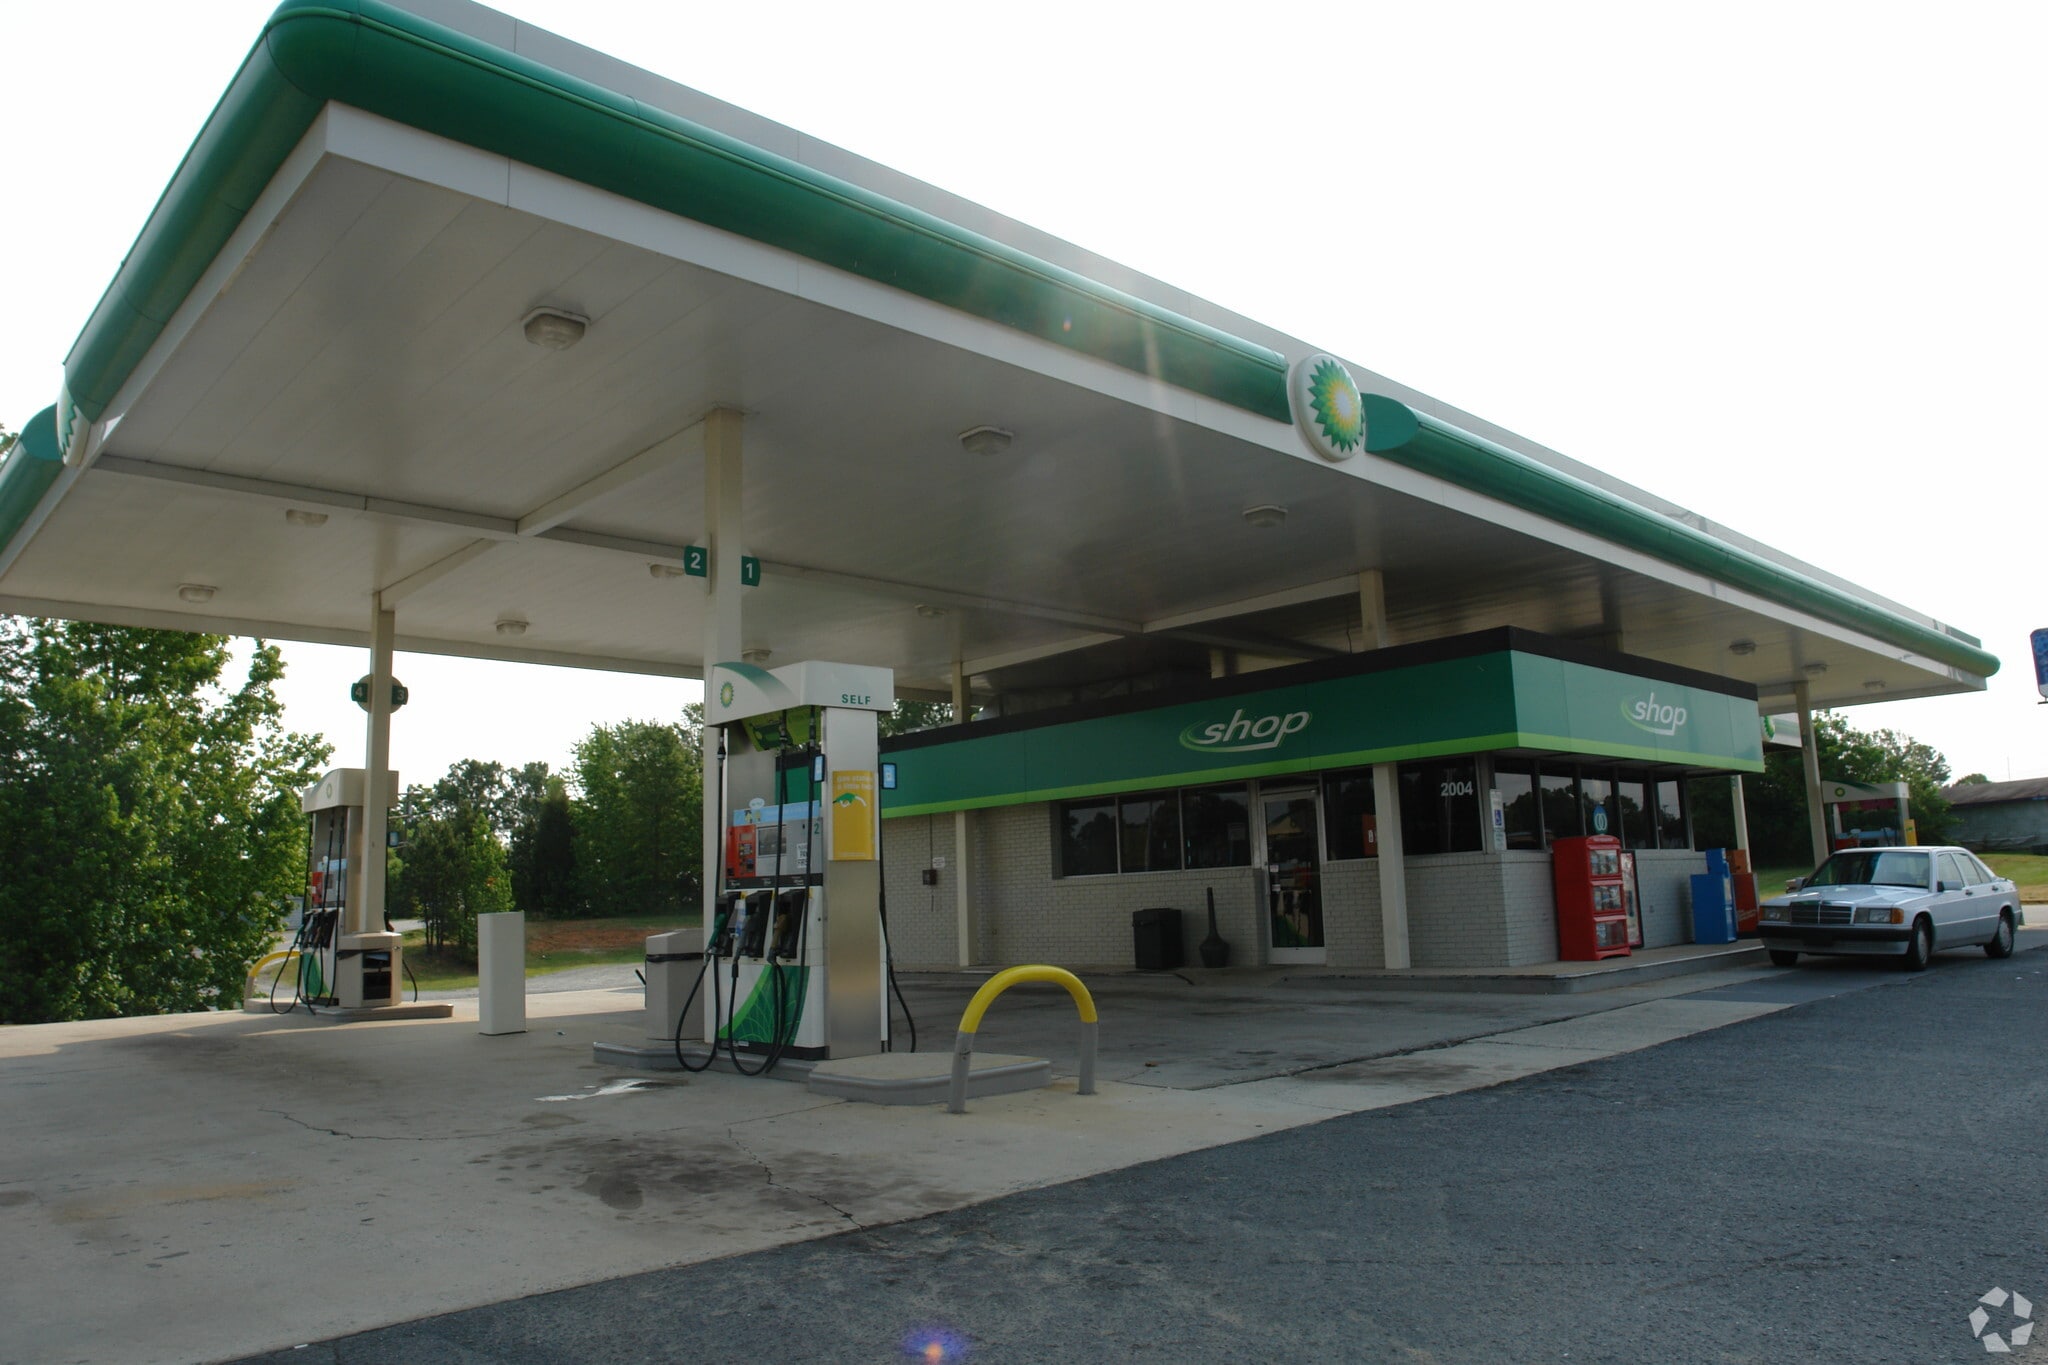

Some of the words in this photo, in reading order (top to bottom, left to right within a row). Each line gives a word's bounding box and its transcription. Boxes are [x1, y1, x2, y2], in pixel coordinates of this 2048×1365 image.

[690, 552, 701, 569] 2
[746, 563, 753, 579] 1
[841, 693, 872, 705] SELF
[1634, 691, 1688, 736] shop
[1196, 708, 1312, 750] shop
[1440, 780, 1474, 797] 2004
[814, 823, 820, 834] 2
